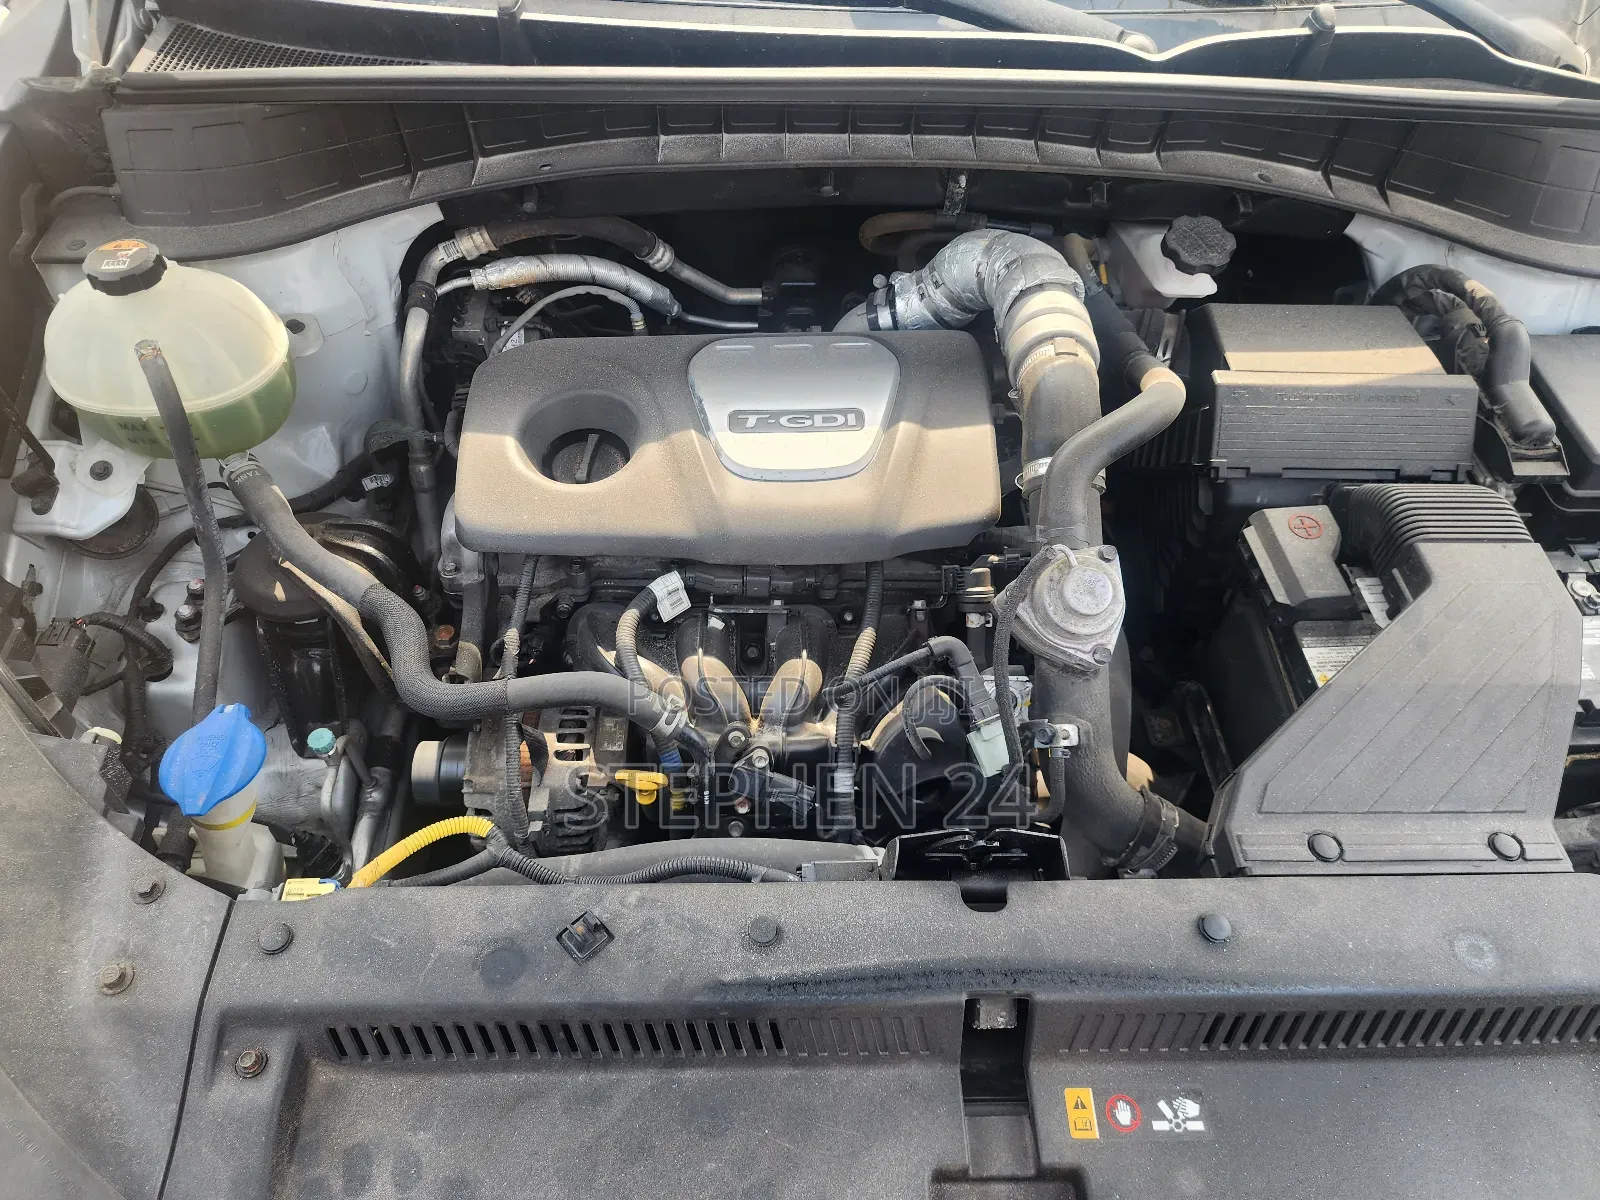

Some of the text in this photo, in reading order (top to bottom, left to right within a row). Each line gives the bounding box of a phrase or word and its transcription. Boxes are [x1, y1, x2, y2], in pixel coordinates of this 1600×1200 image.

[118, 422, 149, 431] MAX
[737, 413, 857, 429] T-GDI
[234, 470, 261, 485] TANK
